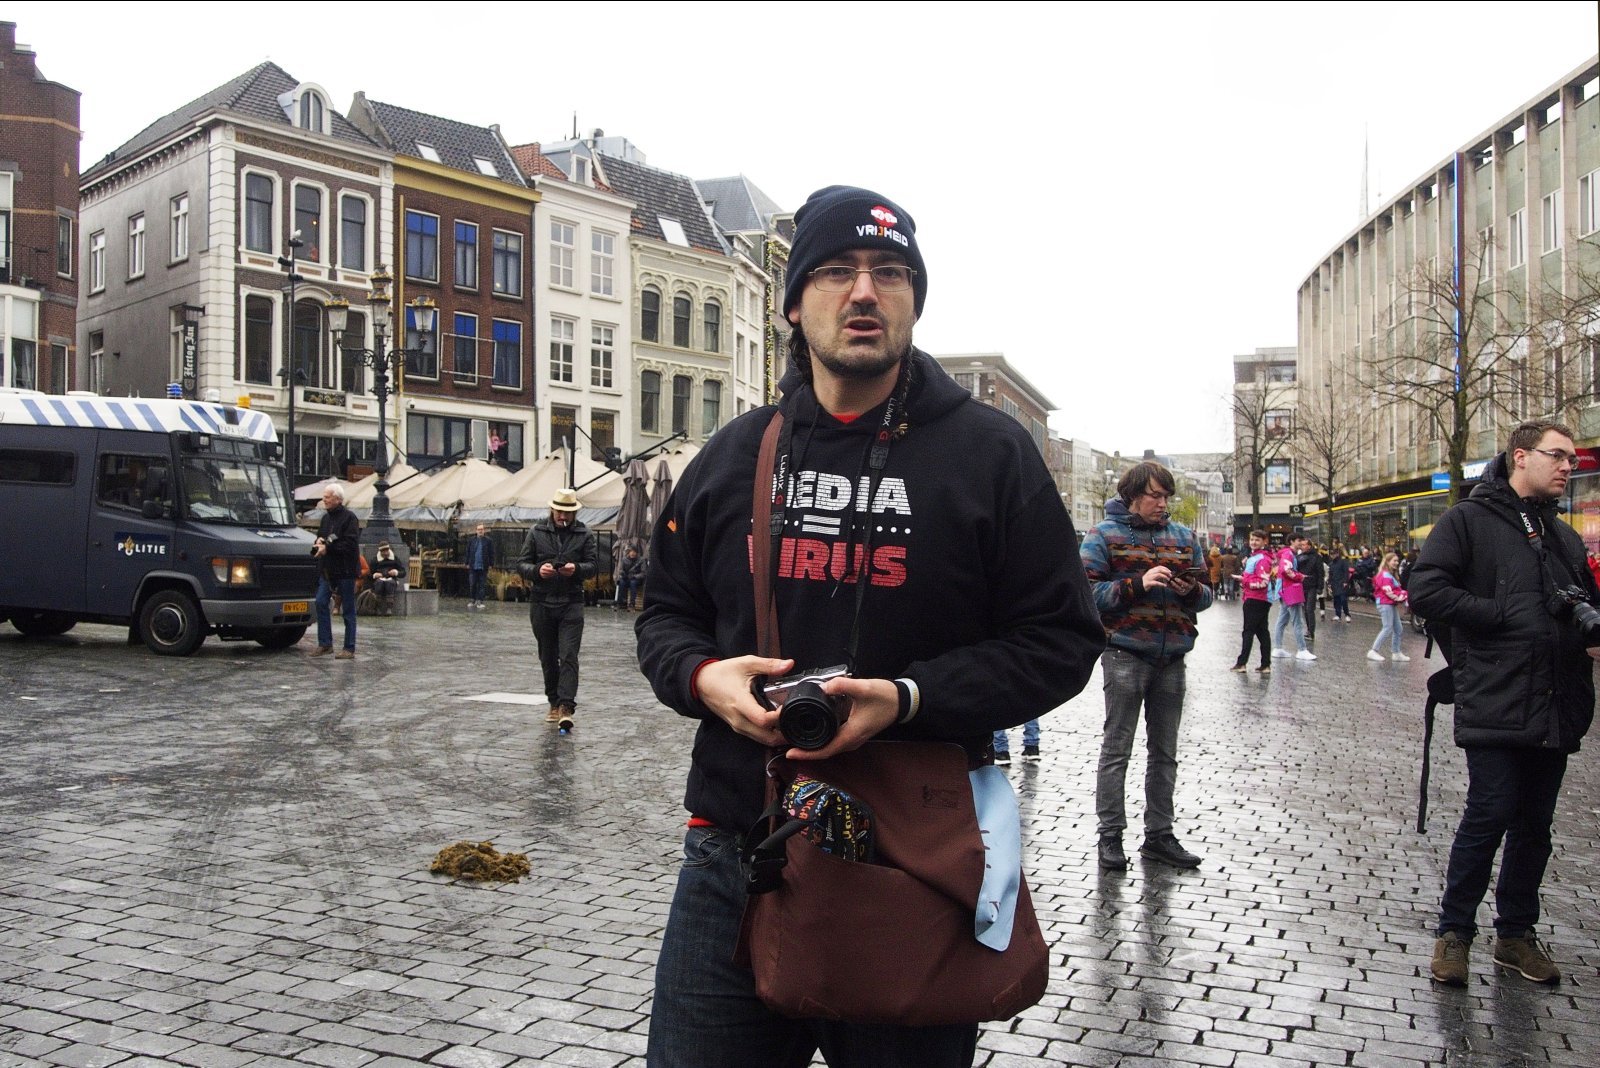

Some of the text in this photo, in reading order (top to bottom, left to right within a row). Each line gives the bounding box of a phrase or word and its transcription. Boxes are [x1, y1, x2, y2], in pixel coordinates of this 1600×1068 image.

[856, 224, 909, 247] VRIJHEID
[183, 326, 197, 378] Hertog Jan
[882, 397, 897, 426] LUMIX
[778, 454, 788, 490] LUMIX
[1520, 511, 1534, 533] SONY
[117, 541, 166, 556] POLITIE
